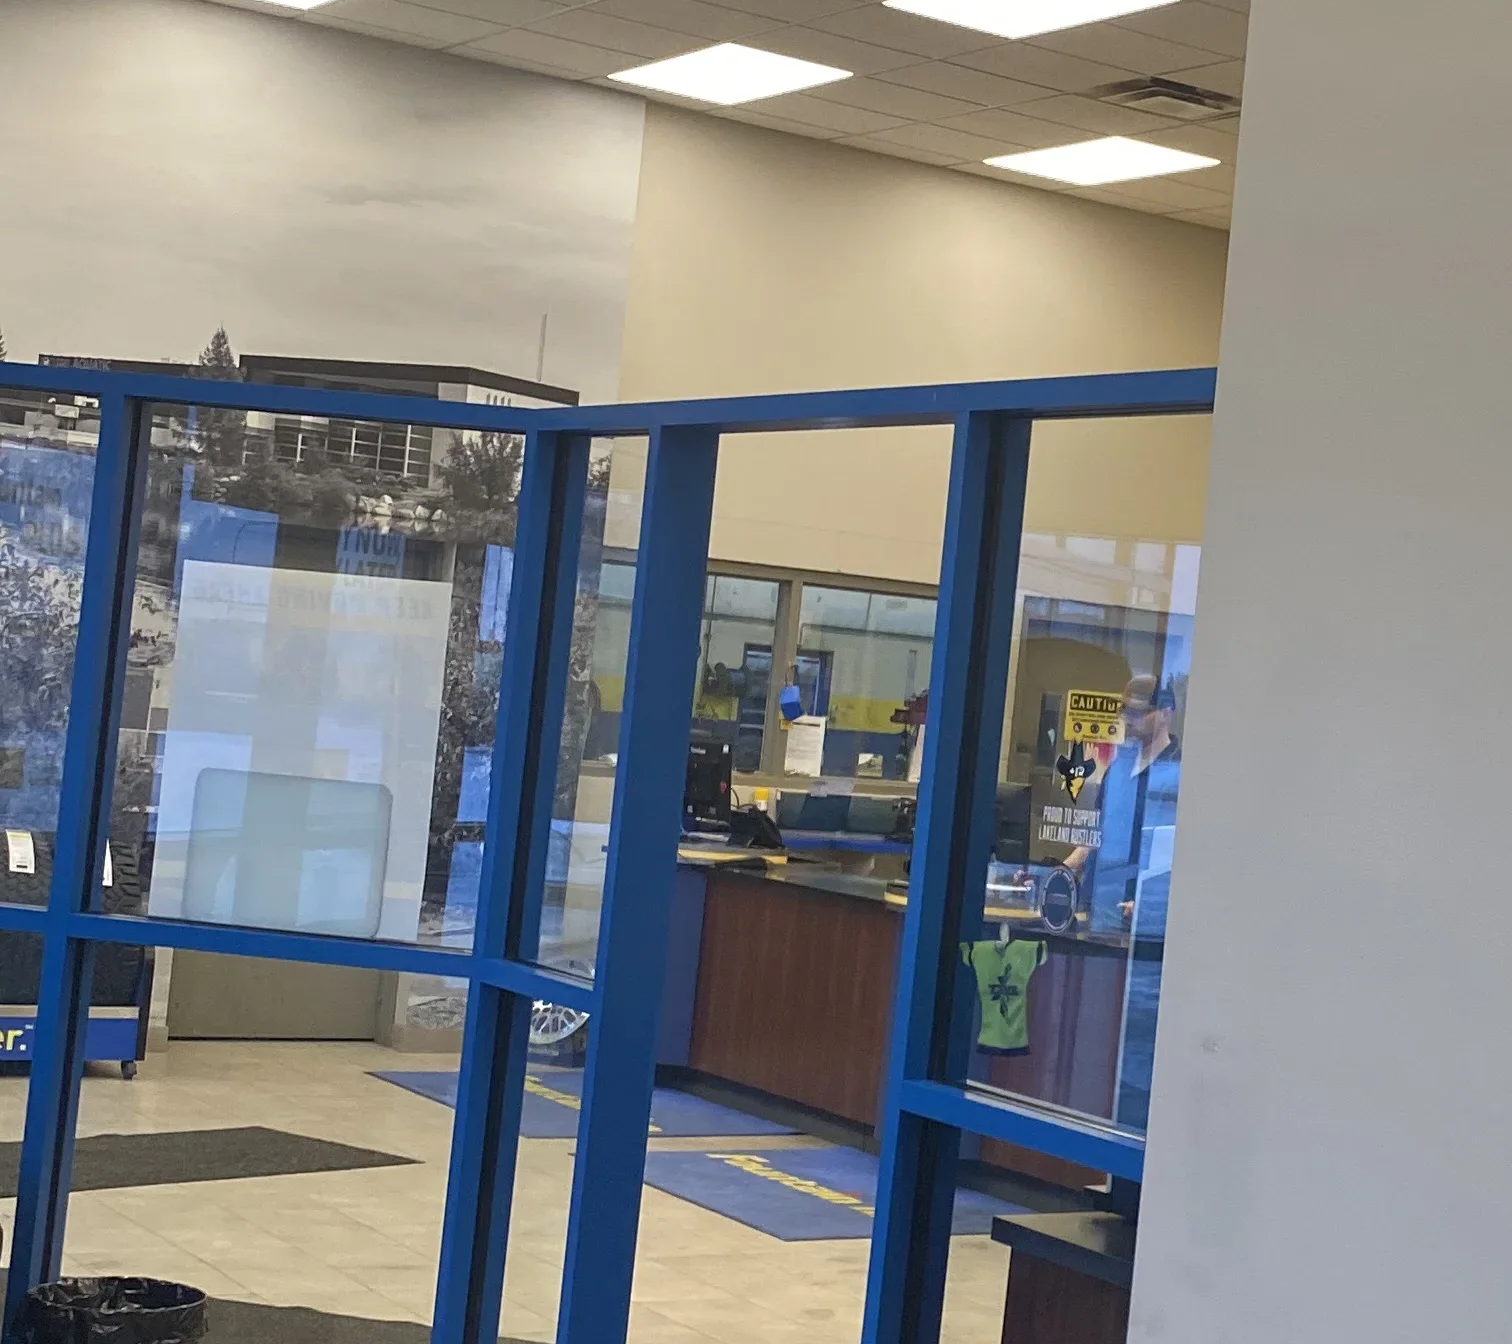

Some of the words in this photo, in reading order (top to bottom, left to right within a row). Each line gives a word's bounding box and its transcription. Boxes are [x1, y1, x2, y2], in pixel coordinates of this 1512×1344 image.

[1043, 805, 1063, 823] PROUD
[1064, 807, 1072, 825] TO
[1073, 808, 1101, 827] SUPPORT
[1038, 823, 1070, 843] LAKELAND
